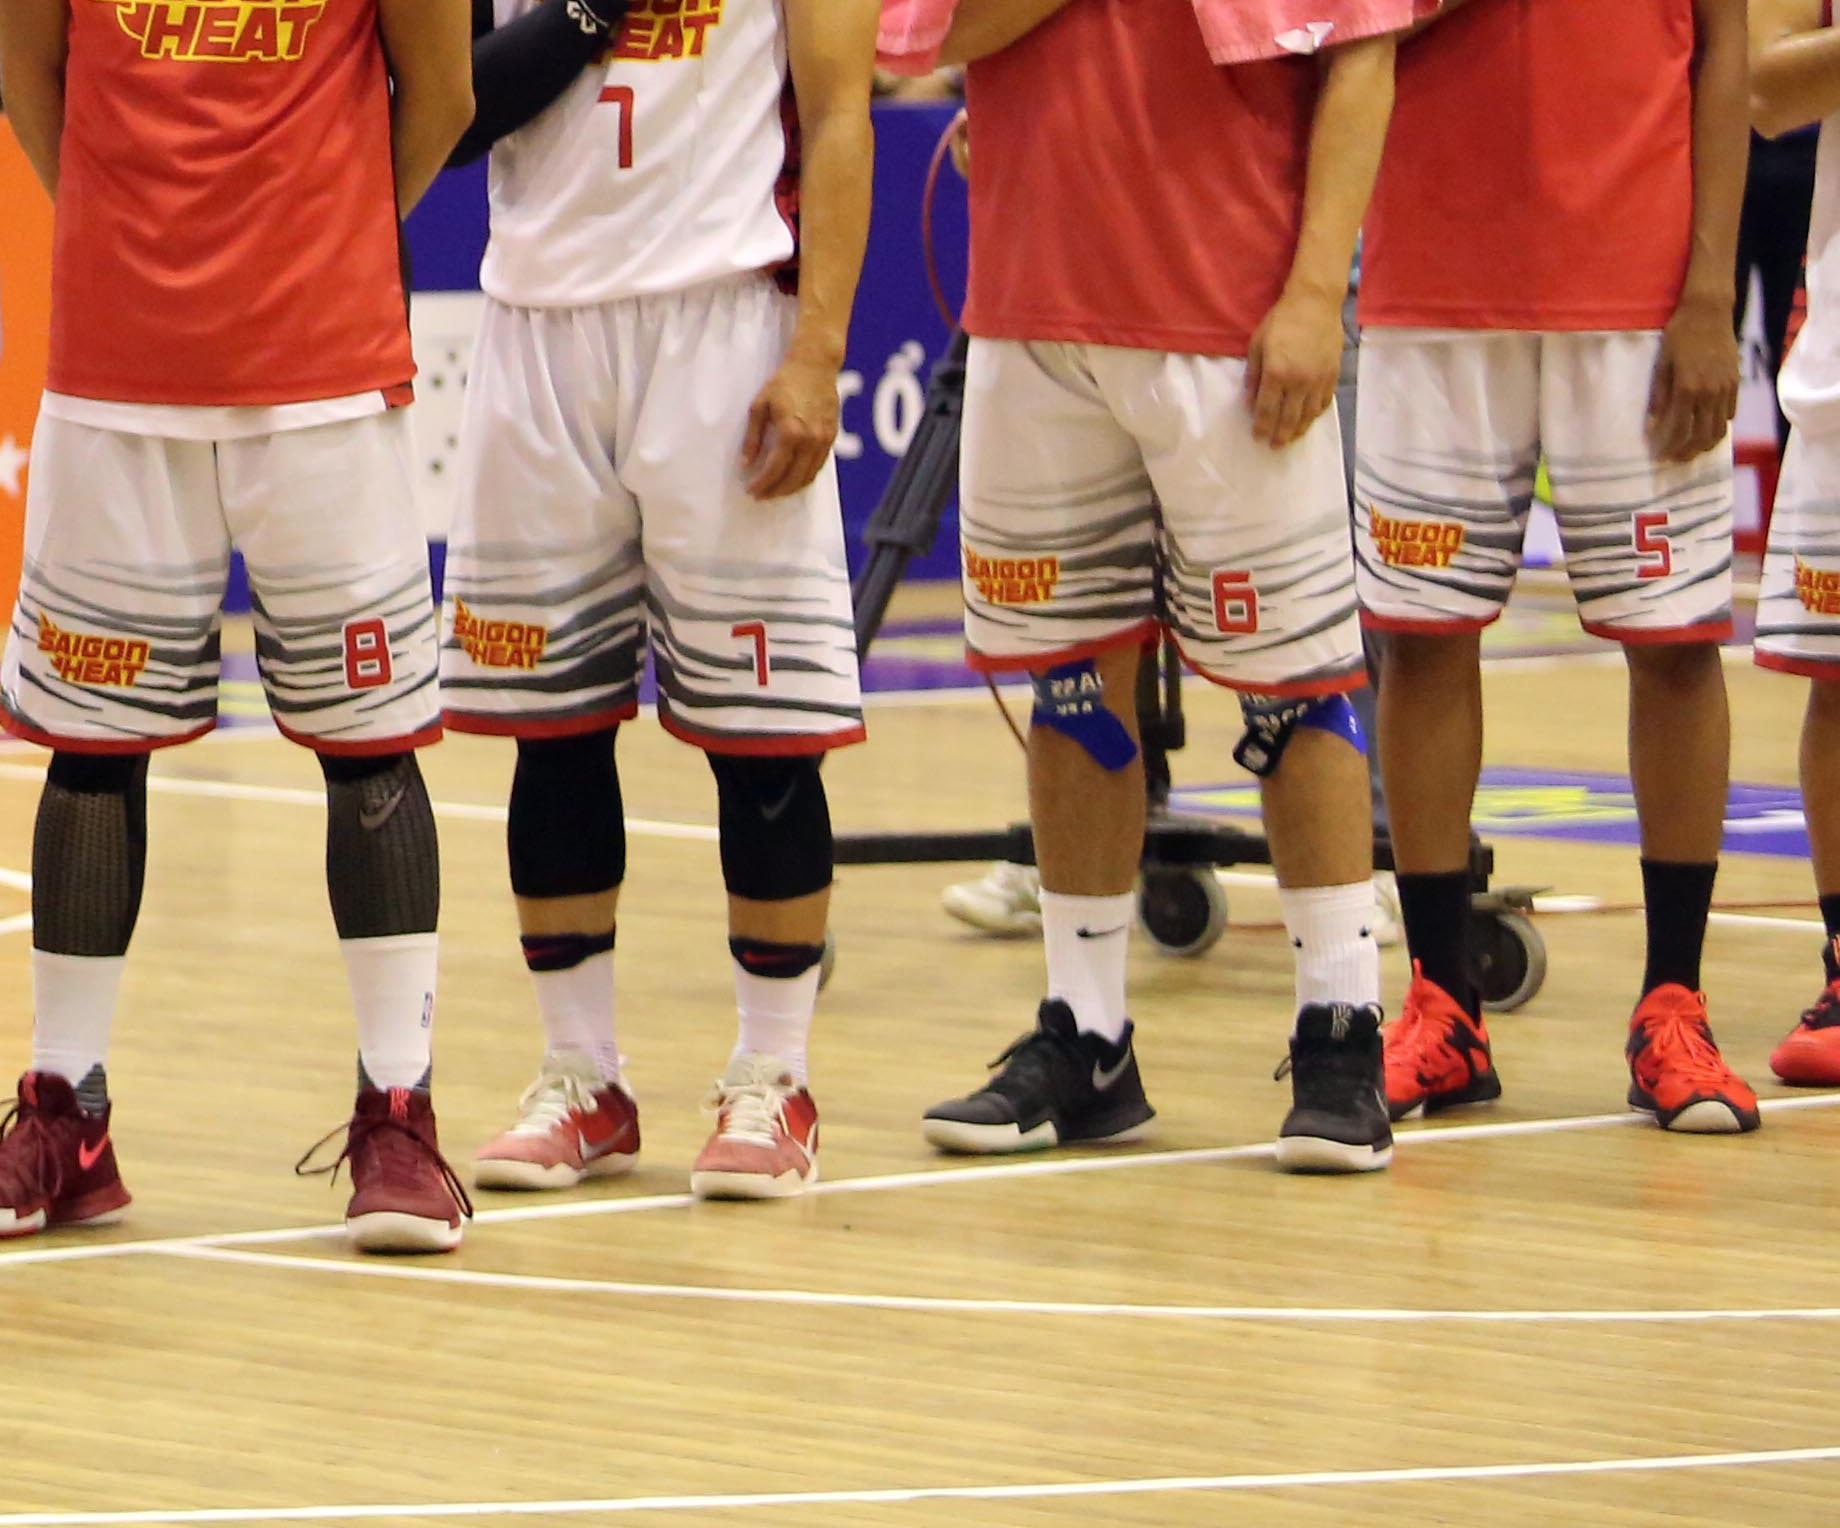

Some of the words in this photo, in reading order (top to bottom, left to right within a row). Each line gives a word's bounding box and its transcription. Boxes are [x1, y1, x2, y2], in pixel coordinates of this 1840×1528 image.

[140, 2, 325, 61] HEAT
[598, 85, 634, 168] 7
[1383, 539, 1459, 567] HEAT
[1630, 512, 1671, 578] 5
[986, 578, 1058, 604] HEAT
[1211, 569, 1258, 634] 6
[38, 628, 149, 664] SAIGON
[344, 618, 392, 689] 8
[453, 615, 545, 648] SAIGON
[471, 639, 542, 668] HEAT
[731, 621, 772, 688] 7
[60, 655, 144, 686] HEAT
